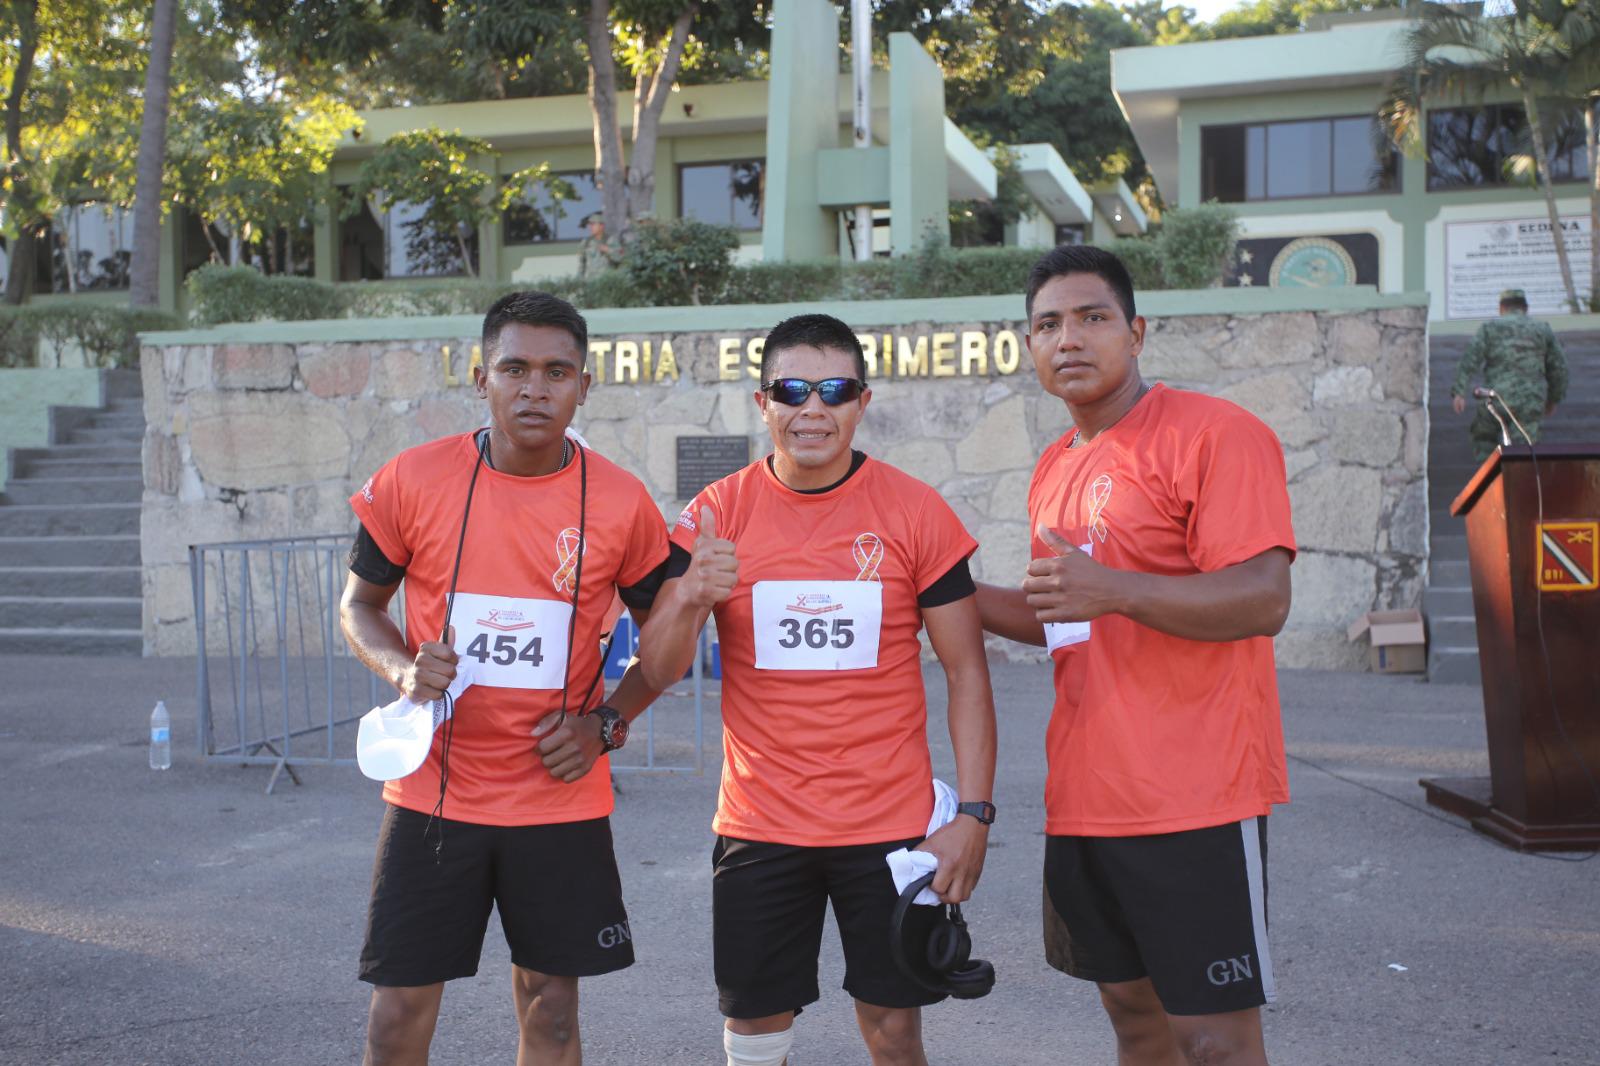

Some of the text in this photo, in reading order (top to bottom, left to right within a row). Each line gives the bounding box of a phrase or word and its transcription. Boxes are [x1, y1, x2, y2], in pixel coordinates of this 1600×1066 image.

[583, 339, 680, 383] TRIA
[860, 329, 1020, 377] RIMERO
[778, 618, 855, 649] 365
[466, 633, 544, 667] 454
[597, 920, 632, 949] GN
[1207, 954, 1253, 986] GN
